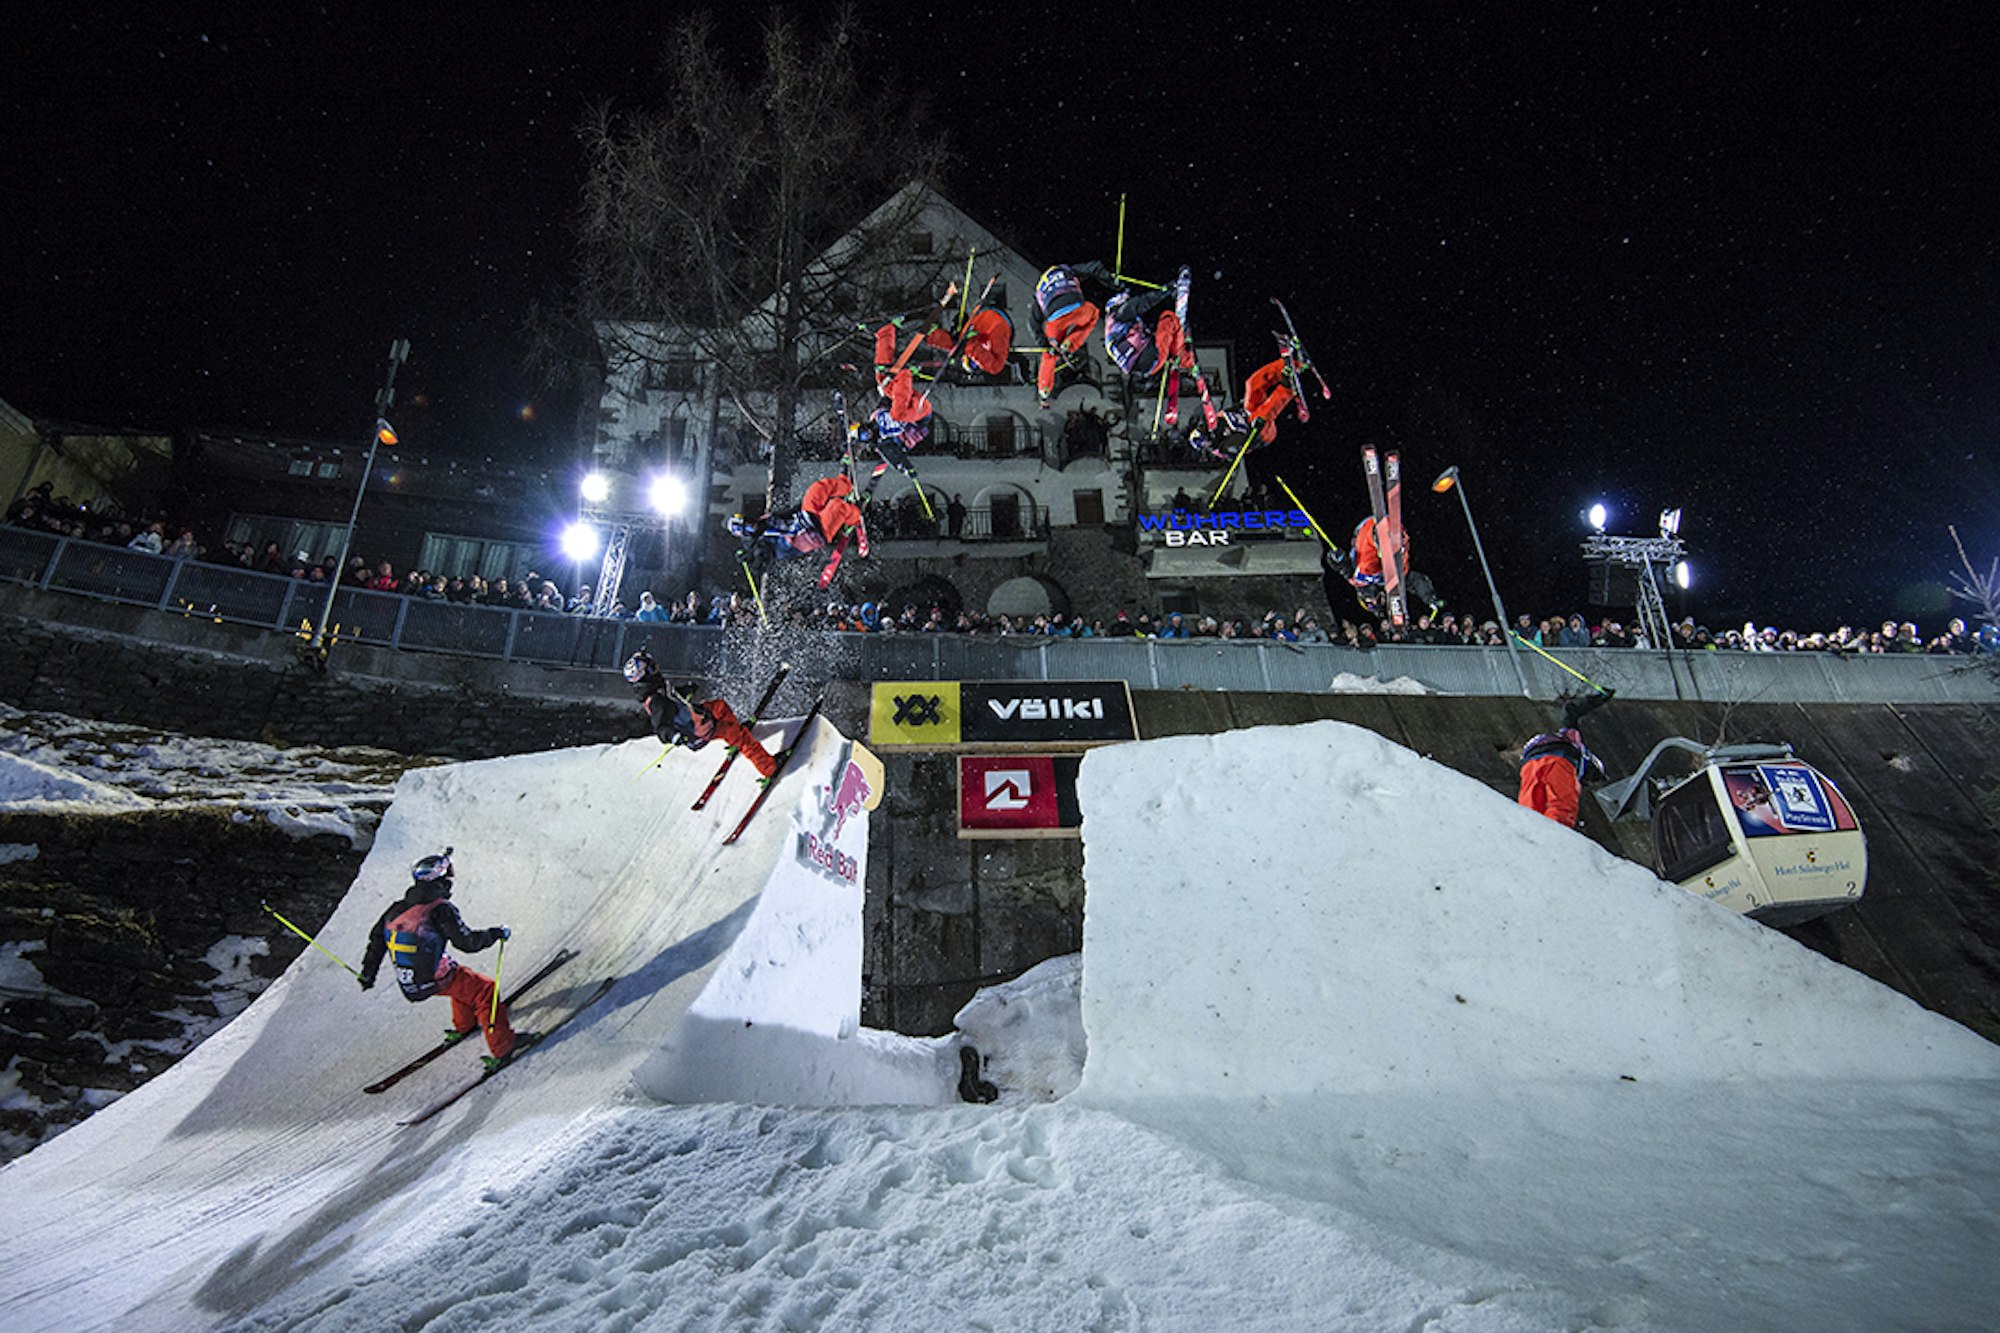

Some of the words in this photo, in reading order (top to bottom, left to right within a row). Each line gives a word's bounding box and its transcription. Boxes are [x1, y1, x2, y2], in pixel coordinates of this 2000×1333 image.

[1138, 507, 1310, 531] WÜHRERS
[1165, 530, 1229, 547] BAR
[808, 833, 833, 870] Red
[1846, 881, 1857, 896] 2
[1746, 892, 1760, 908] 2
